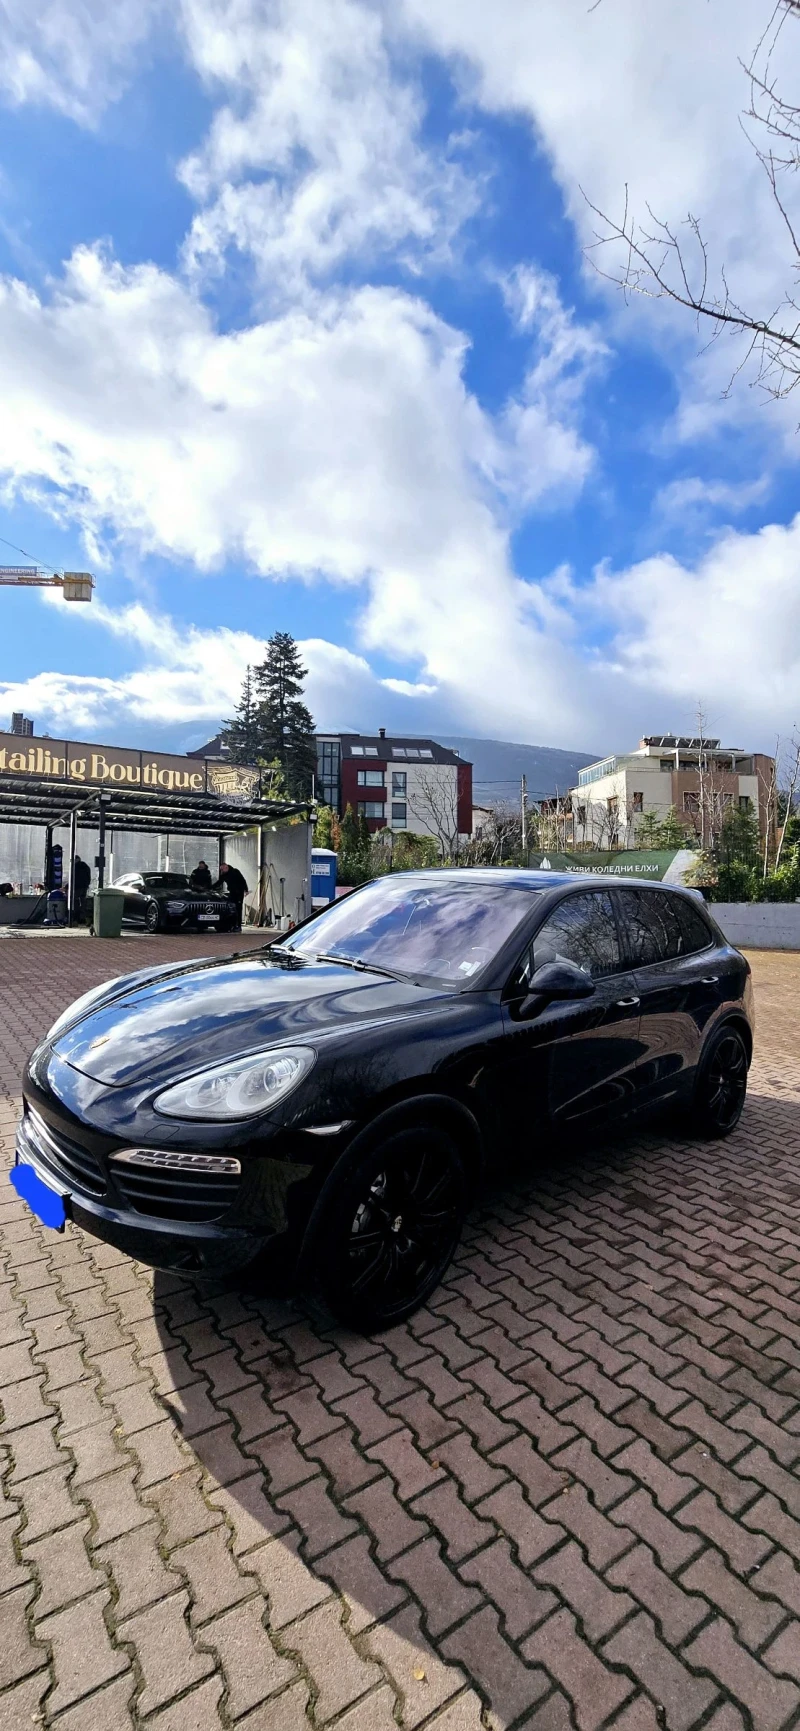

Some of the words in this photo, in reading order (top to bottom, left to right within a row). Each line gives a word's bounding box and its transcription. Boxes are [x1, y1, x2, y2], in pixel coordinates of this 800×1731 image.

[0, 747, 87, 781] tailing
[90, 754, 203, 790] Boutique
[591, 864, 634, 874] КОЛЕДНИ
[635, 864, 659, 872] ЕЛХИ
